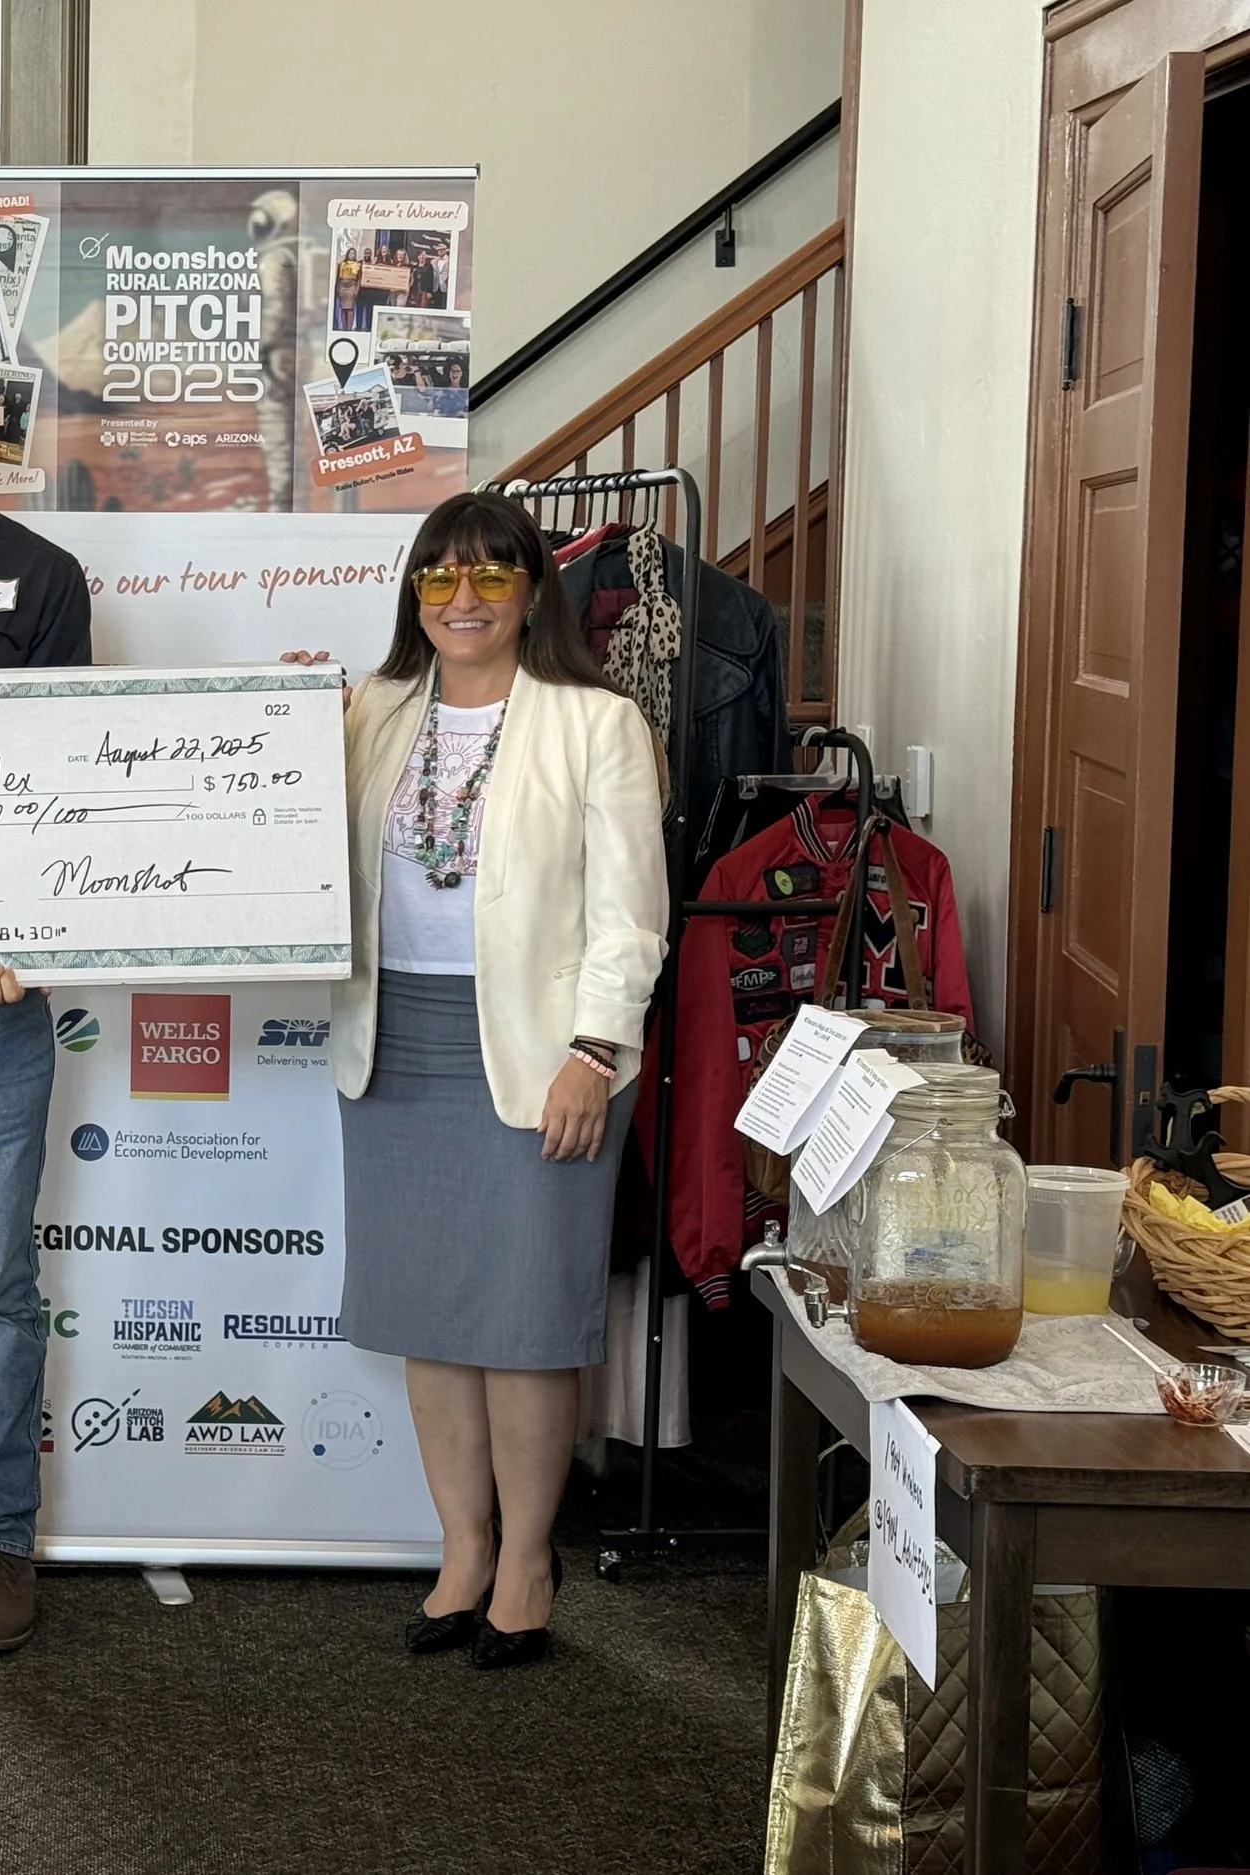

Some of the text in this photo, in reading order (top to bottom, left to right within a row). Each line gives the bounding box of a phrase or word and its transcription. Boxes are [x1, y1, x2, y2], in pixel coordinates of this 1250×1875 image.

[336, 202, 462, 221] Last Year's Winner!
[106, 245, 259, 270] Moonshot
[106, 273, 262, 291] RURAL ARIZONA
[105, 294, 262, 340] PITCH
[103, 341, 260, 362] COMPETITION
[102, 363, 264, 403] 2025
[101, 419, 158, 429] Presented by
[182, 433, 208, 447] aps
[214, 433, 265, 443] ARIZONA
[318, 436, 416, 475] Prescott, AZ
[6, 470, 39, 486] More!
[116, 574, 170, 595] our
[180, 561, 247, 592] tour
[257, 544, 405, 608] sponsors!
[264, 704, 291, 716] 022
[67, 754, 89, 763] DATE
[95, 731, 168, 778] August
[205, 811, 246, 820] DOLLARS
[41, 855, 233, 896] Moonshot
[736, 970, 770, 988] FMP
[139, 1022, 221, 1041] WELLS
[141, 1046, 221, 1065] FARGO
[257, 1054, 308, 1069] Delivering
[115, 1130, 261, 1146] Arizona Association for
[114, 1144, 268, 1163] Economic Development
[162, 1227, 324, 1256] SPONSORS
[121, 1299, 194, 1320] TUCSON
[113, 1320, 201, 1342] HISPANIC
[113, 1343, 149, 1351] CHAMBER
[158, 1344, 202, 1352] COMMERCE
[263, 1341, 329, 1350] COPPER
[126, 1408, 163, 1416] ARIZONA
[126, 1416, 164, 1426] STITCH
[127, 1426, 165, 1442] LAB
[185, 1426, 285, 1443] AWD LAW
[318, 1421, 365, 1440] IDIA
